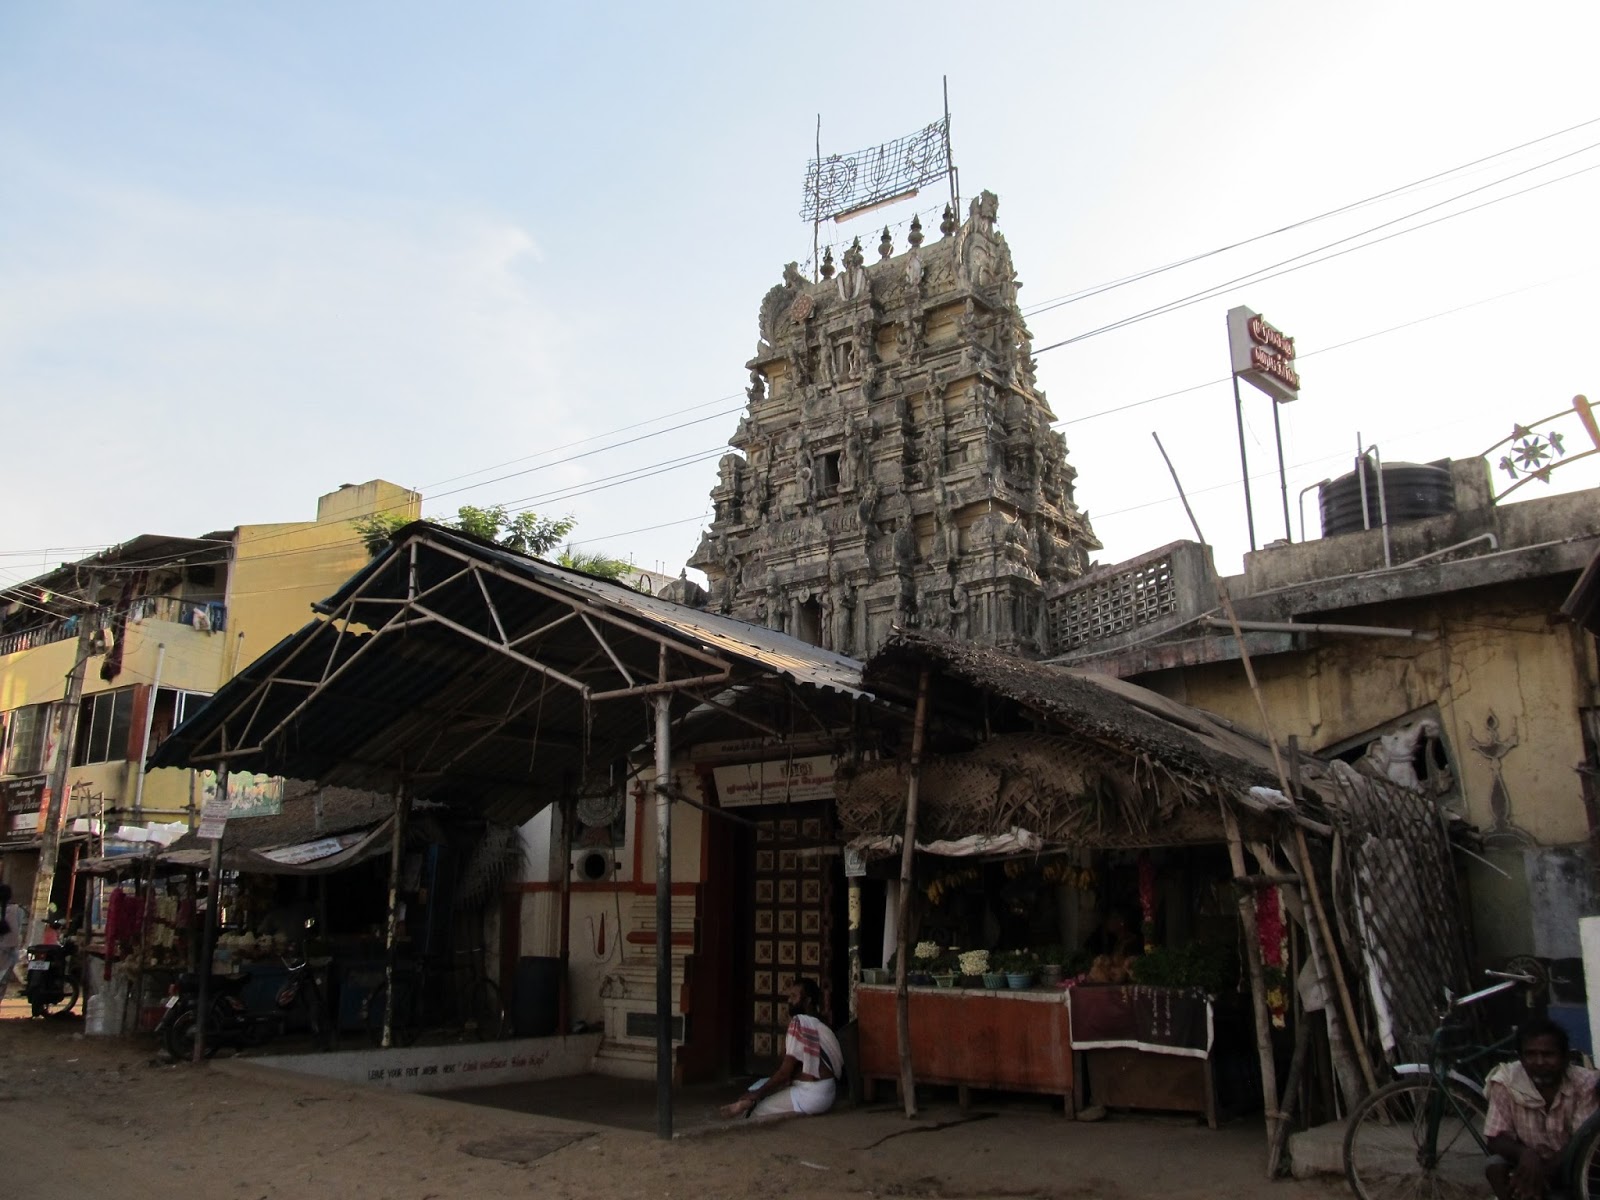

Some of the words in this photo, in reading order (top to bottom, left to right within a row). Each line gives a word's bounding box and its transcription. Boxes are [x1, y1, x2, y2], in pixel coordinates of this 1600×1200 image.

[367, 1068, 384, 1080] LEAVE
[387, 1067, 402, 1078] YOUR
[405, 1066, 420, 1077] FOOT
